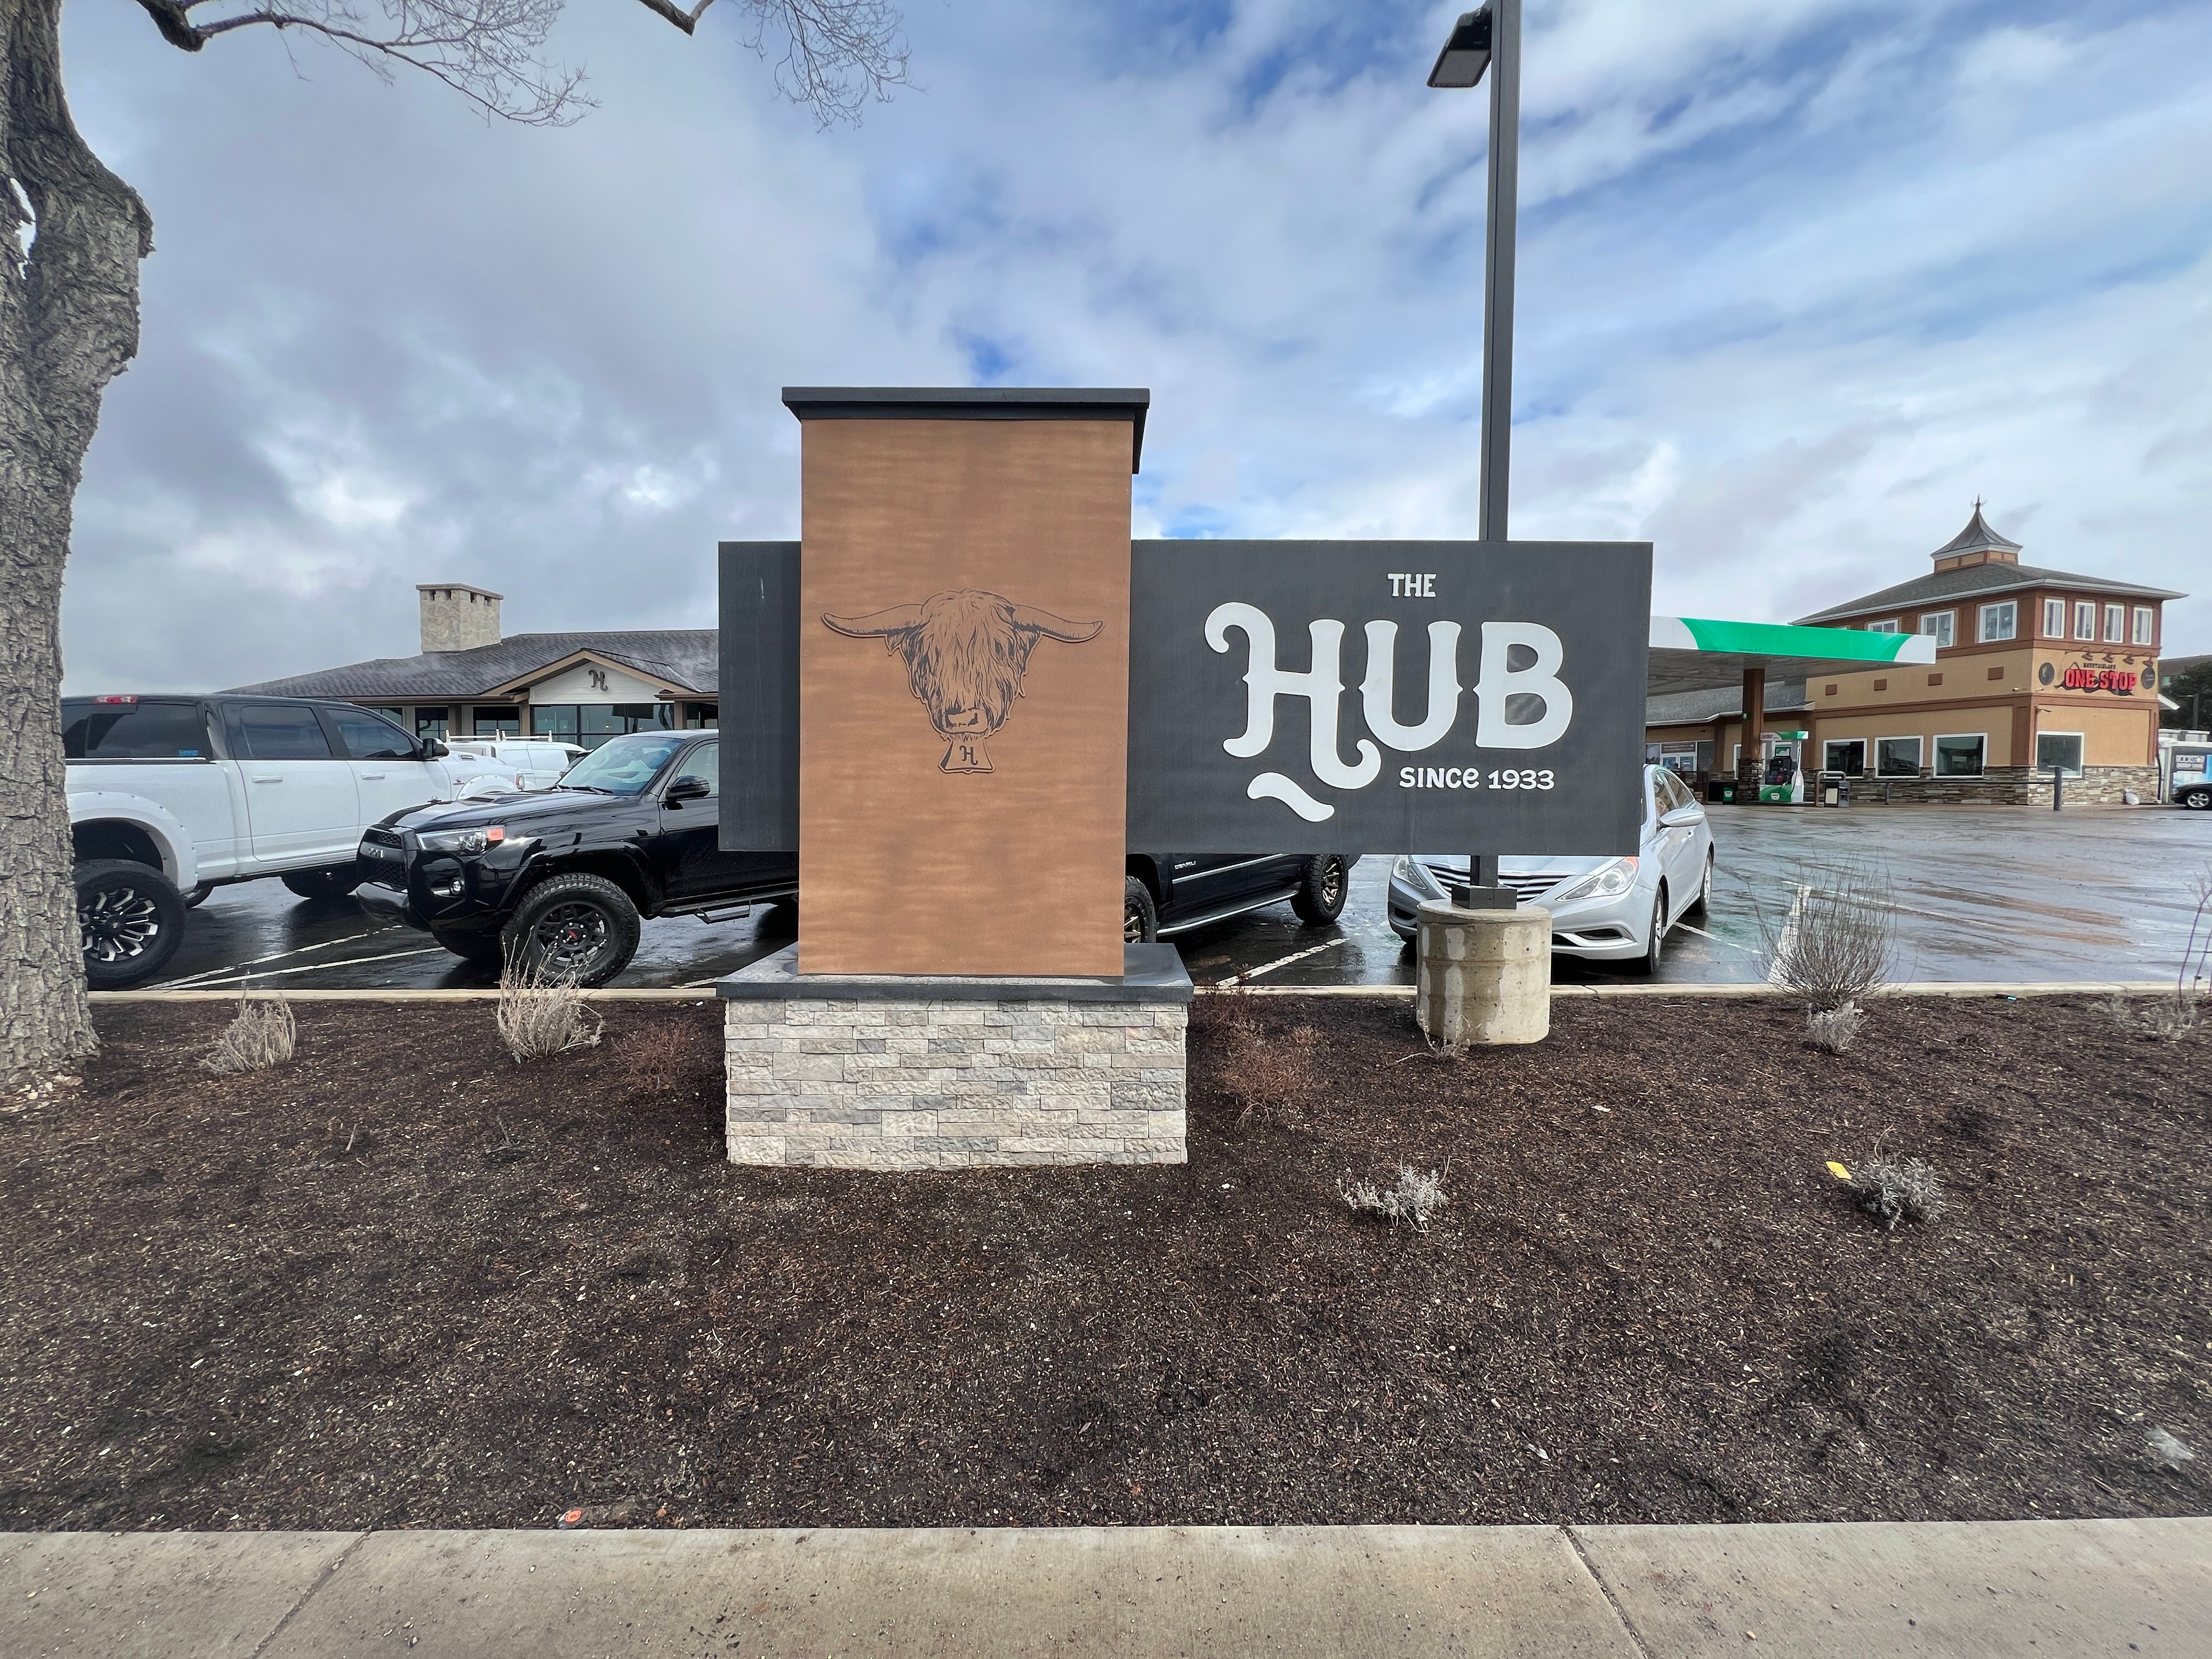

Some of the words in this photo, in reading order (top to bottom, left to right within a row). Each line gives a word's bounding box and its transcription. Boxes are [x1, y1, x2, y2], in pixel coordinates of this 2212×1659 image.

[1387, 573, 1437, 597] THE
[588, 669, 608, 691] H
[2065, 669, 2095, 688] ONE
[2099, 670, 2137, 690] STOP
[1204, 602, 1573, 790] HUB
[959, 745, 978, 766] H
[1487, 769, 1555, 790] 1933
